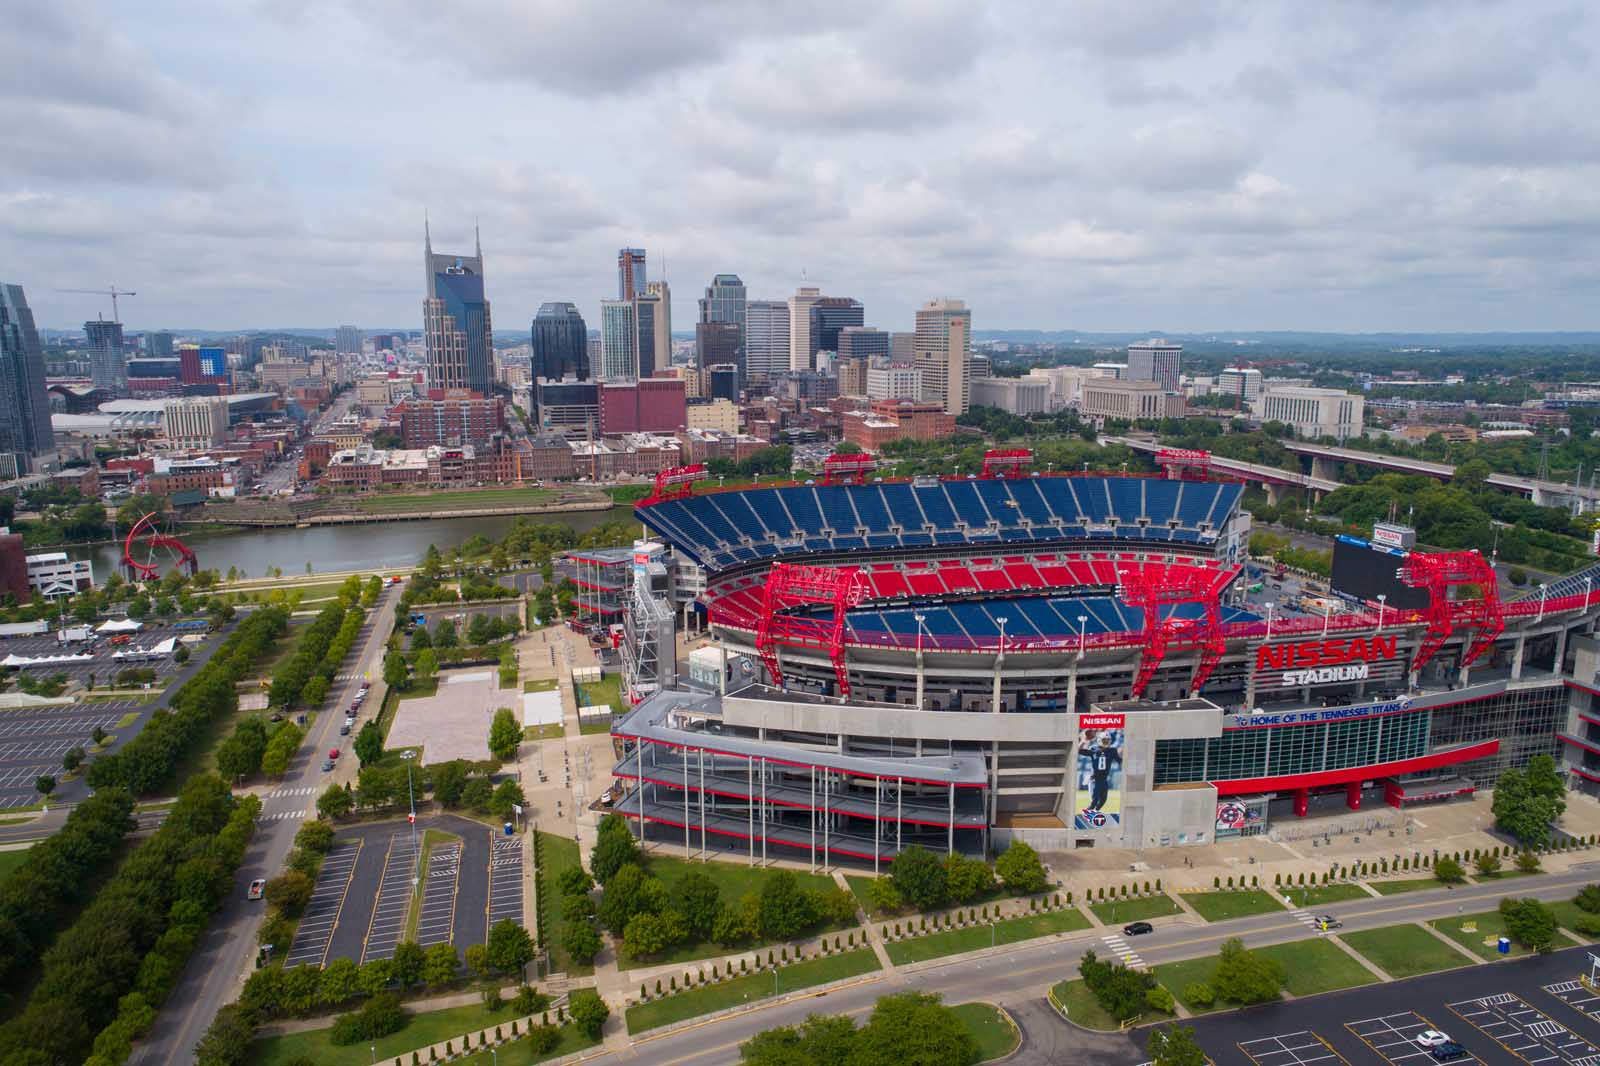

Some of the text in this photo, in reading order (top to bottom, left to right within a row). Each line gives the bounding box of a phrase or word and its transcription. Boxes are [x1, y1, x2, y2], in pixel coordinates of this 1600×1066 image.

[1376, 530, 1400, 540] NISSAN
[1255, 634, 1397, 670] NISSAN
[1282, 665, 1369, 686] STADIUM
[1250, 702, 1400, 726] HOME OF THE TENNESSEE TITANS
[1098, 756, 1106, 770] 8
